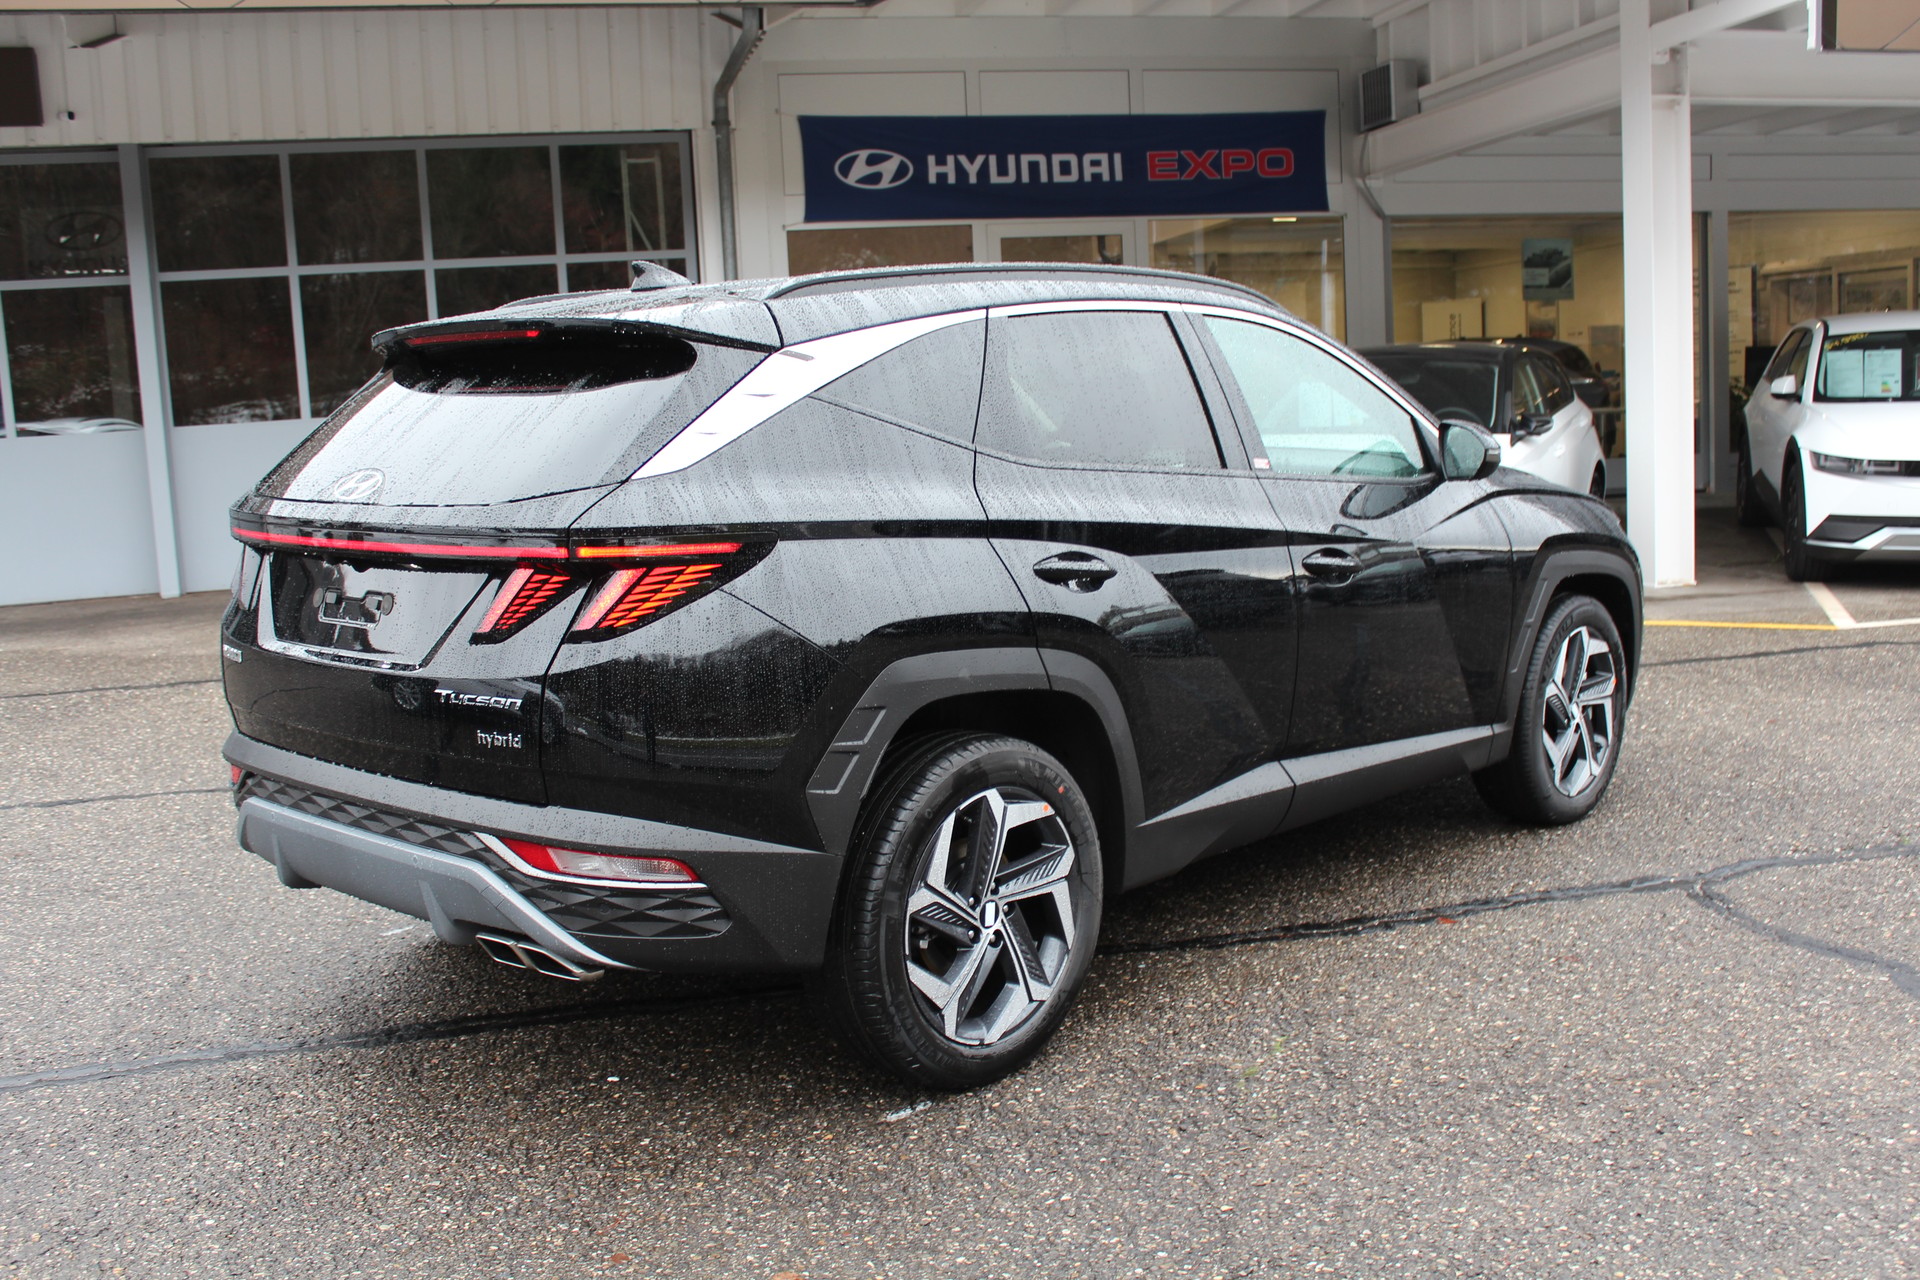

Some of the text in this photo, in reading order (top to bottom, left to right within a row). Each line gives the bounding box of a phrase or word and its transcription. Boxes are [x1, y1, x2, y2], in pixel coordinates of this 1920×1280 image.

[927, 148, 1294, 184] HYUNDAI EXPO
[477, 729, 522, 749] hybrid
